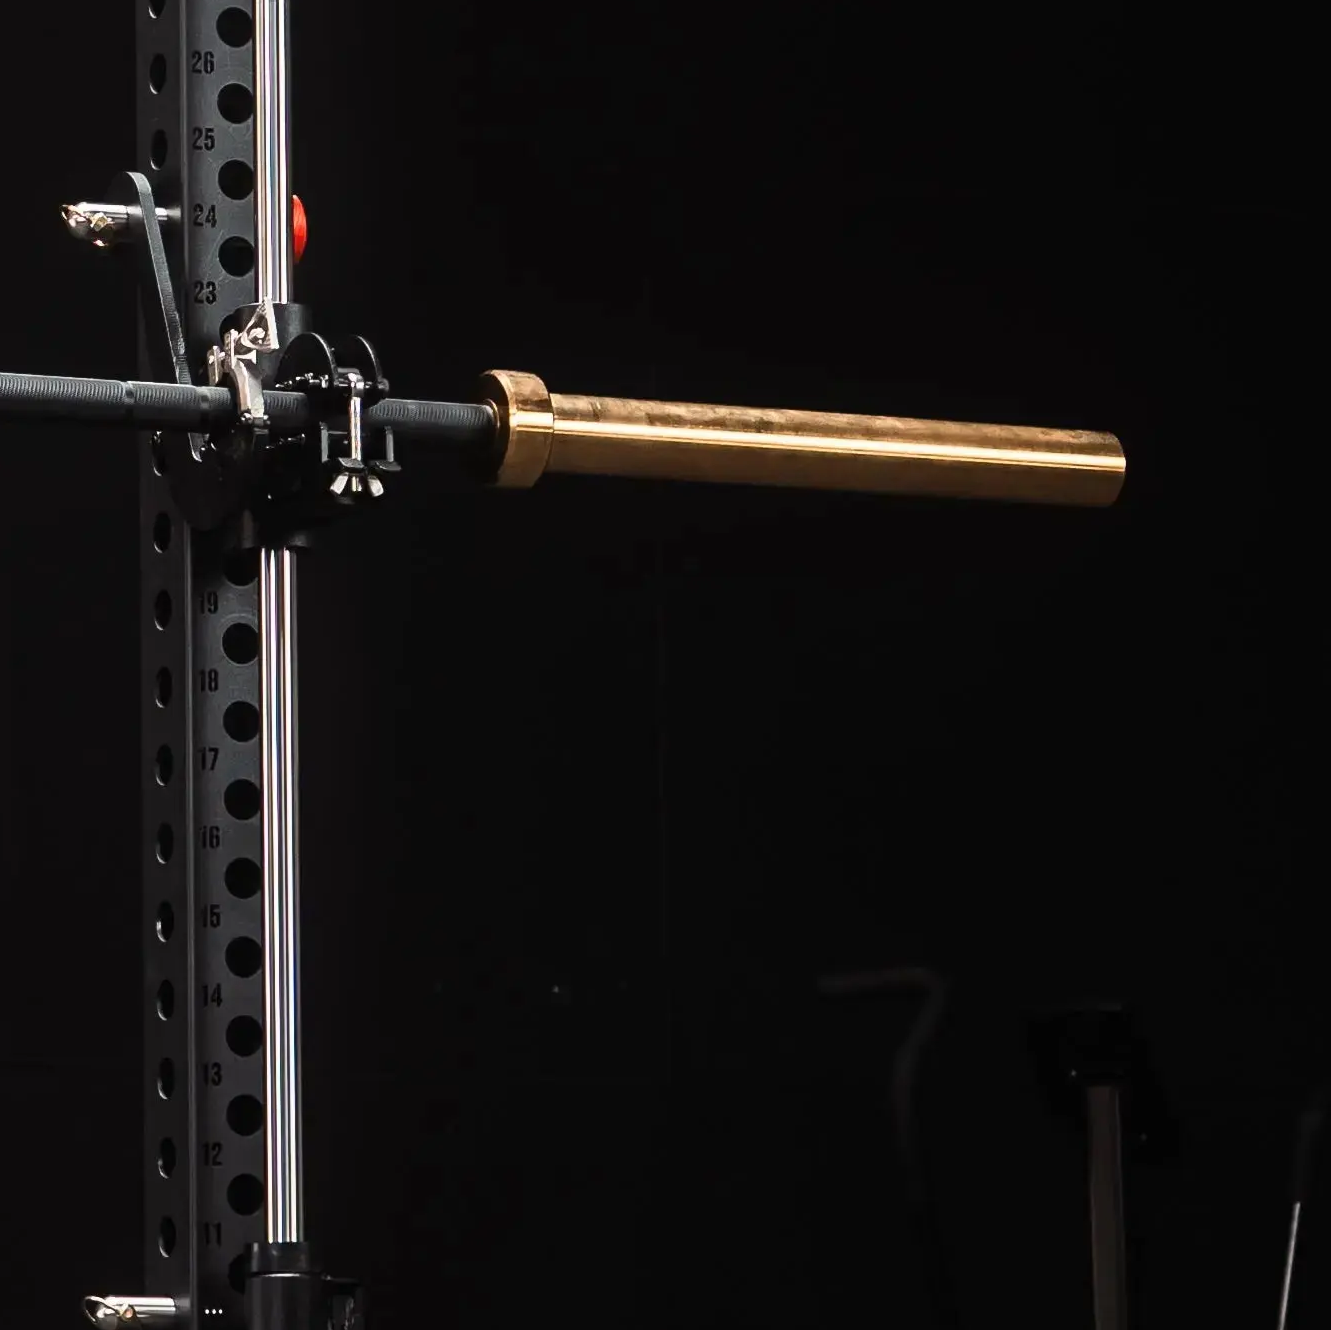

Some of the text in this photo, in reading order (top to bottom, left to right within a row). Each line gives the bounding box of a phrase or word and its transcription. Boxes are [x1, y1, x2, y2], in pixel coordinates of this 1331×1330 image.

[192, 50, 215, 75] 26
[192, 127, 216, 152] 25
[193, 203, 218, 229] 24
[194, 280, 217, 306] 23
[197, 590, 219, 615] 19
[198, 668, 219, 693] 18
[199, 746, 220, 771] 17
[200, 825, 221, 850] 16
[201, 903, 221, 929] 15
[202, 982, 224, 1008] 14
[202, 1061, 223, 1087] 13
[202, 1141, 223, 1167] 12
[203, 1222, 222, 1247] 11
